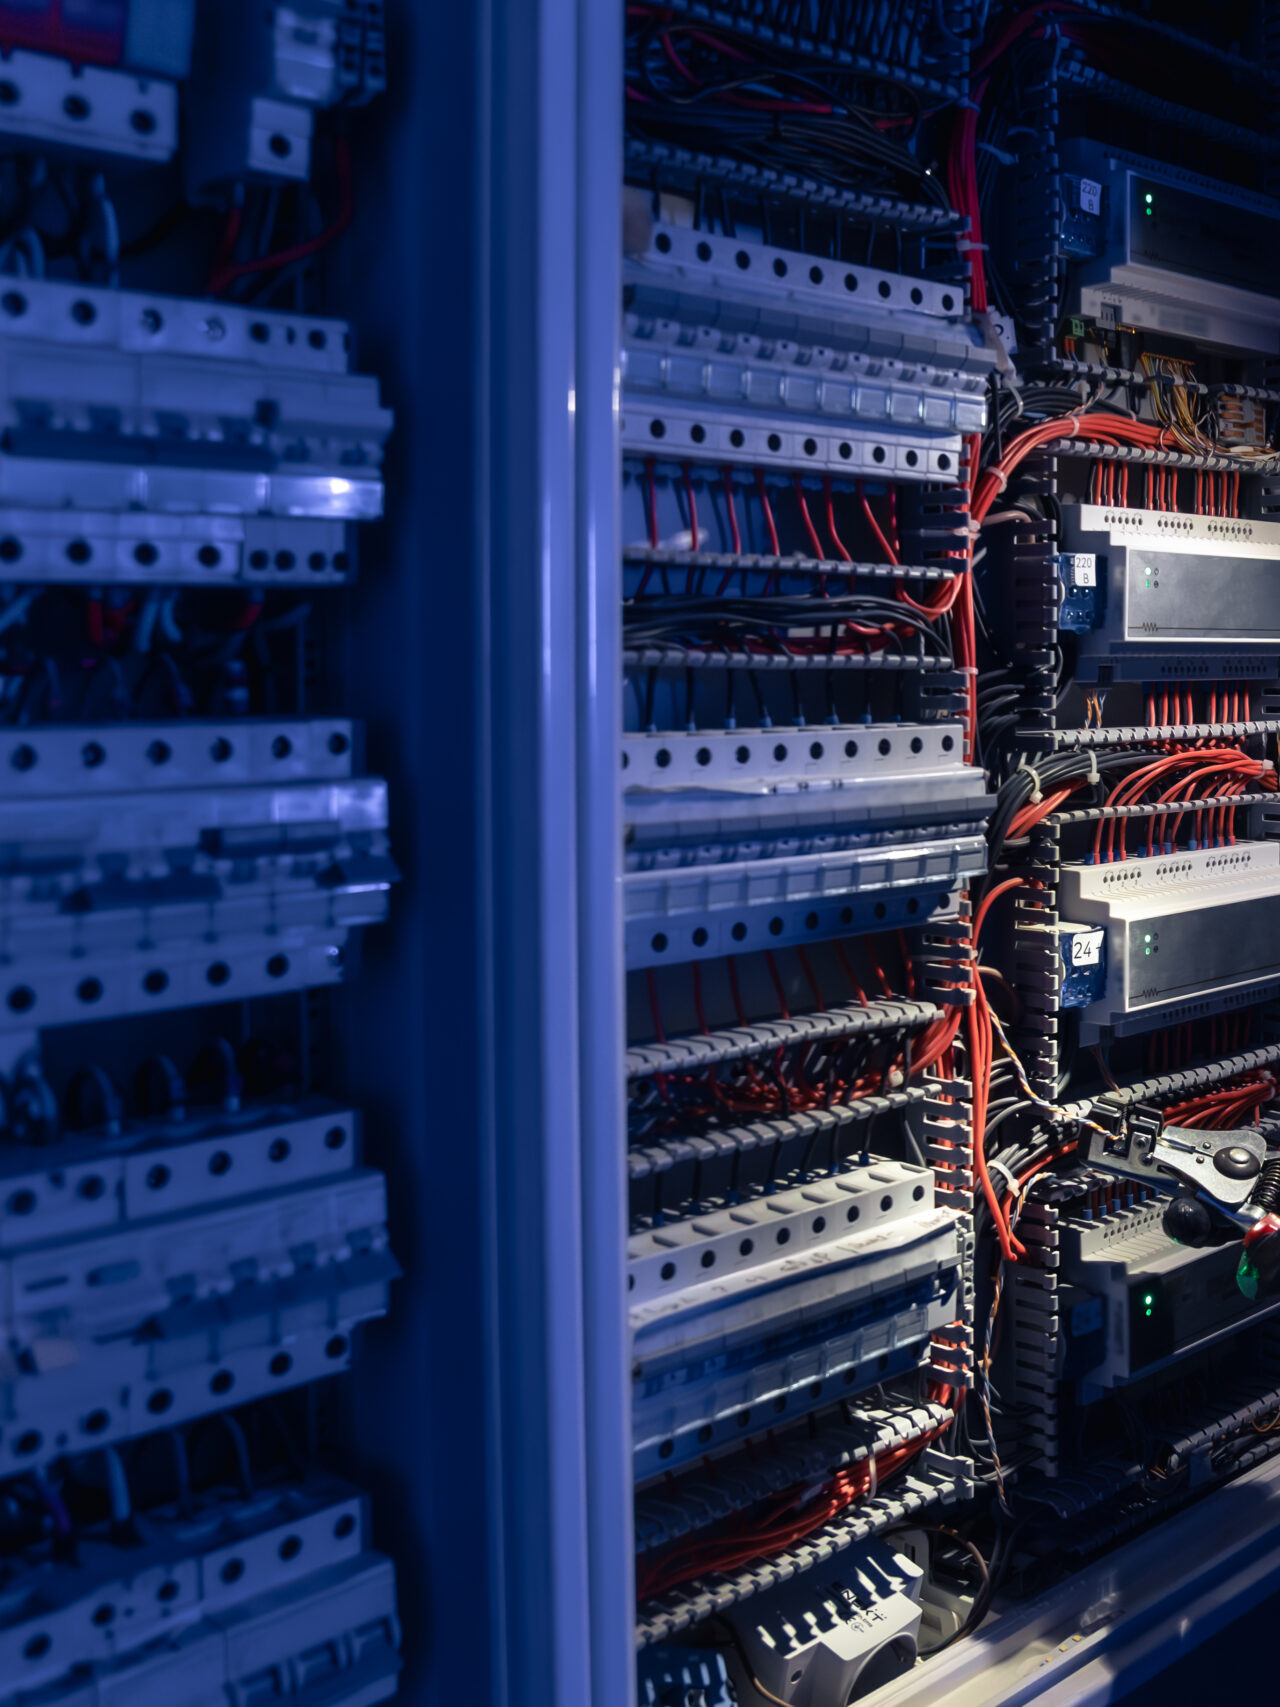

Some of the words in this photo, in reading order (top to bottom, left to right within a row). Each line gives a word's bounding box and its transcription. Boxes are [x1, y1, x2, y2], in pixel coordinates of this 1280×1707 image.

[1082, 182, 1097, 197] 220
[1076, 557, 1092, 569] 220
[1083, 572, 1090, 584] B
